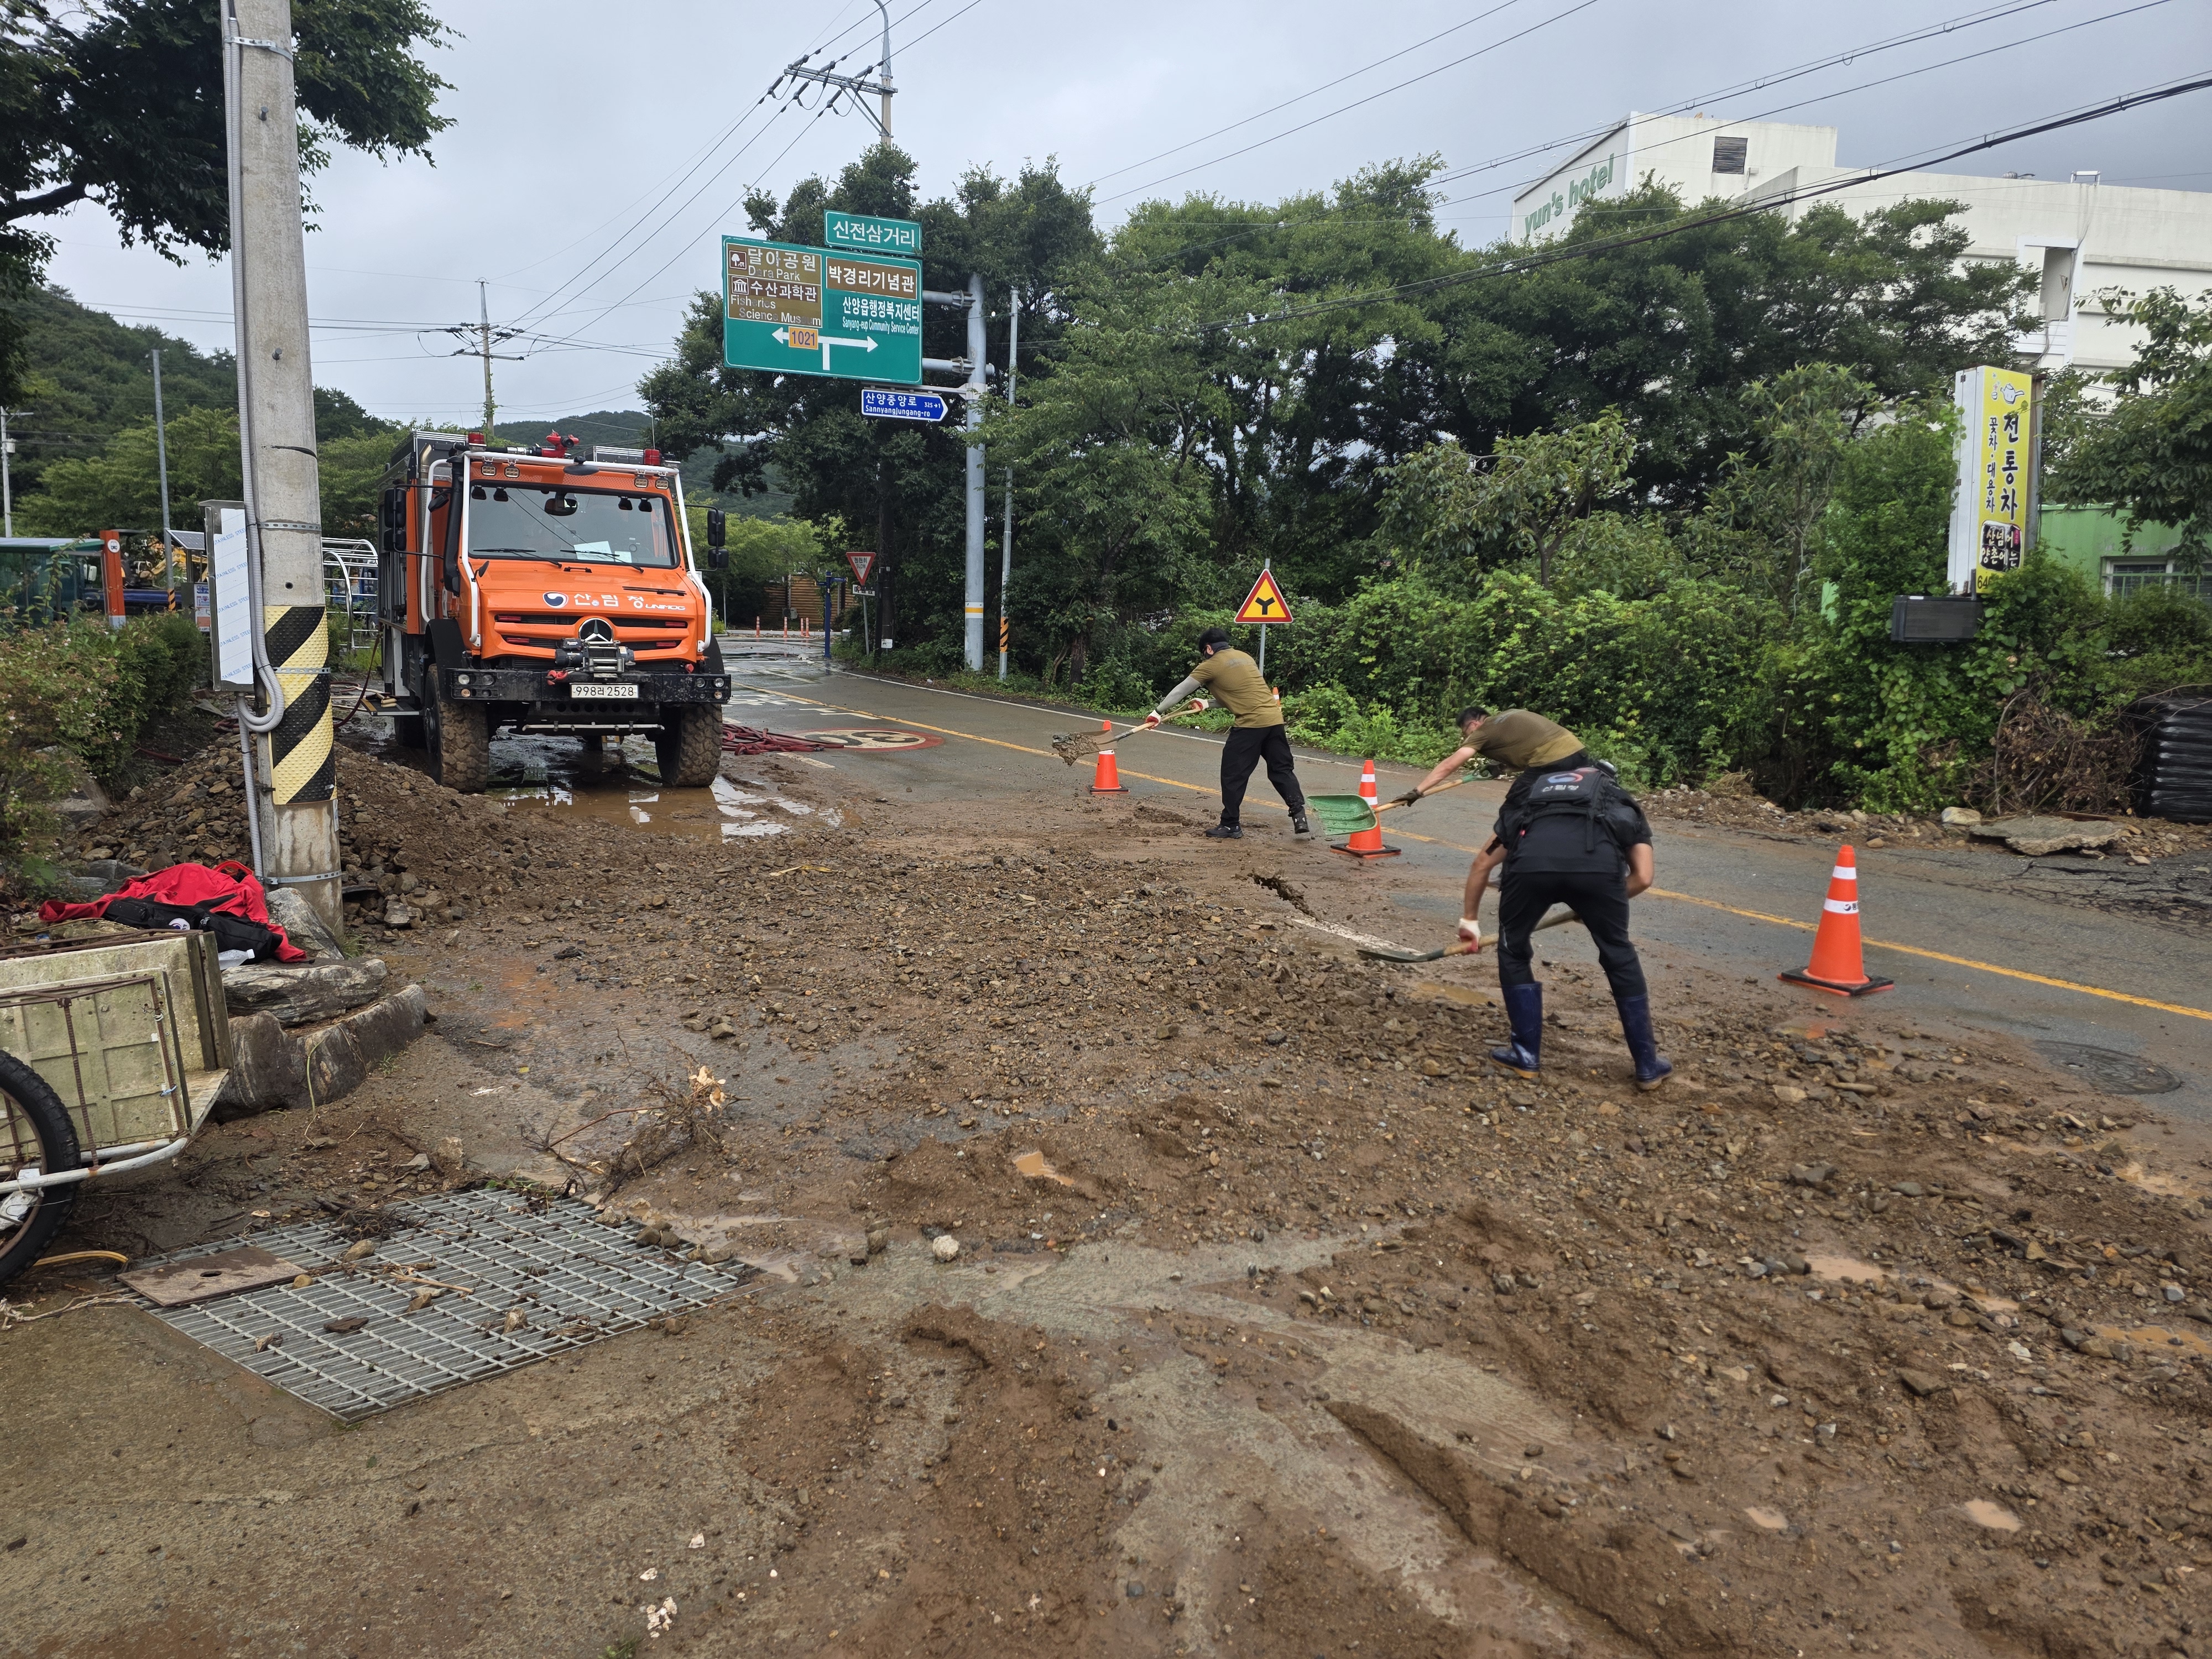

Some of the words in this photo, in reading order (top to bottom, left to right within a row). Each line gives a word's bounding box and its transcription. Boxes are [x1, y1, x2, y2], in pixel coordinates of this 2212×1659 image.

[1524, 191, 1564, 243] yun's
[1568, 153, 1615, 209] hotel
[832, 220, 915, 248] 신전삼거리
[748, 248, 816, 272] 달아공원
[776, 268, 801, 281] Park
[829, 265, 915, 293] 박경리기념관
[750, 280, 817, 302] 수산과학관
[731, 294, 776, 309] Fisheries
[842, 296, 920, 322] 산양읍행정복지센터
[739, 307, 779, 321] Science
[842, 316, 868, 332] Sanyang-eup
[869, 319, 890, 335] Community
[891, 321, 906, 334] Service
[906, 322, 920, 335] Center
[791, 331, 815, 346] 1021
[865, 393, 917, 407] 산양중앙로
[2000, 412, 2018, 520] 전통차
[573, 593, 644, 609] 산림청
